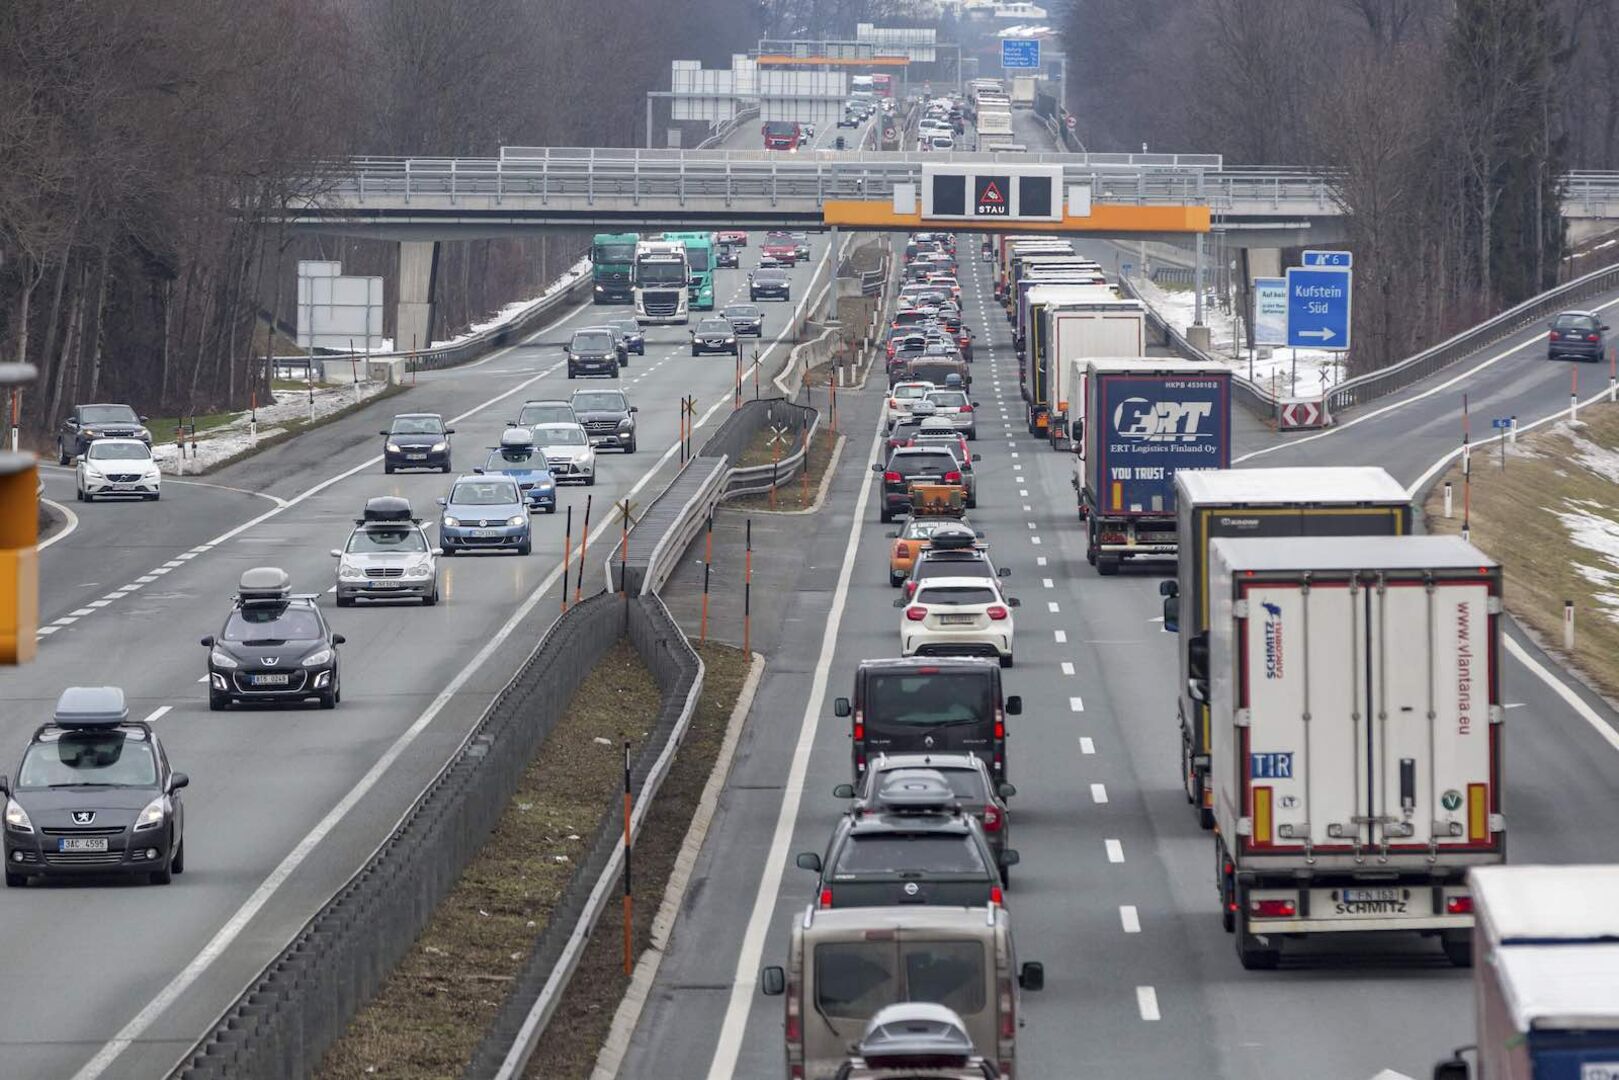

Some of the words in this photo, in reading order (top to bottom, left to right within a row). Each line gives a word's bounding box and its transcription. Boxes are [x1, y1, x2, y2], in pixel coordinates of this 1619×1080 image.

[979, 205, 1005, 213] STAU
[1332, 254, 1340, 264] 6
[1295, 285, 1342, 298] Kufstein
[1302, 302, 1329, 314] -Süd
[1113, 397, 1213, 442] ERT
[1110, 444, 1129, 453] ERT
[1131, 444, 1169, 454] Logistics
[1170, 444, 1203, 453] Finland
[1204, 444, 1217, 454] Oy
[1111, 467, 1132, 480] YOU
[1134, 467, 1165, 480] TRUST
[1265, 621, 1276, 680] SCHMITZ
[1456, 601, 1473, 735] www.vlantana.eu
[1253, 754, 1290, 777] TIR
[65, 840, 81, 849] 3AC
[1335, 902, 1407, 914] SCHMITZ
